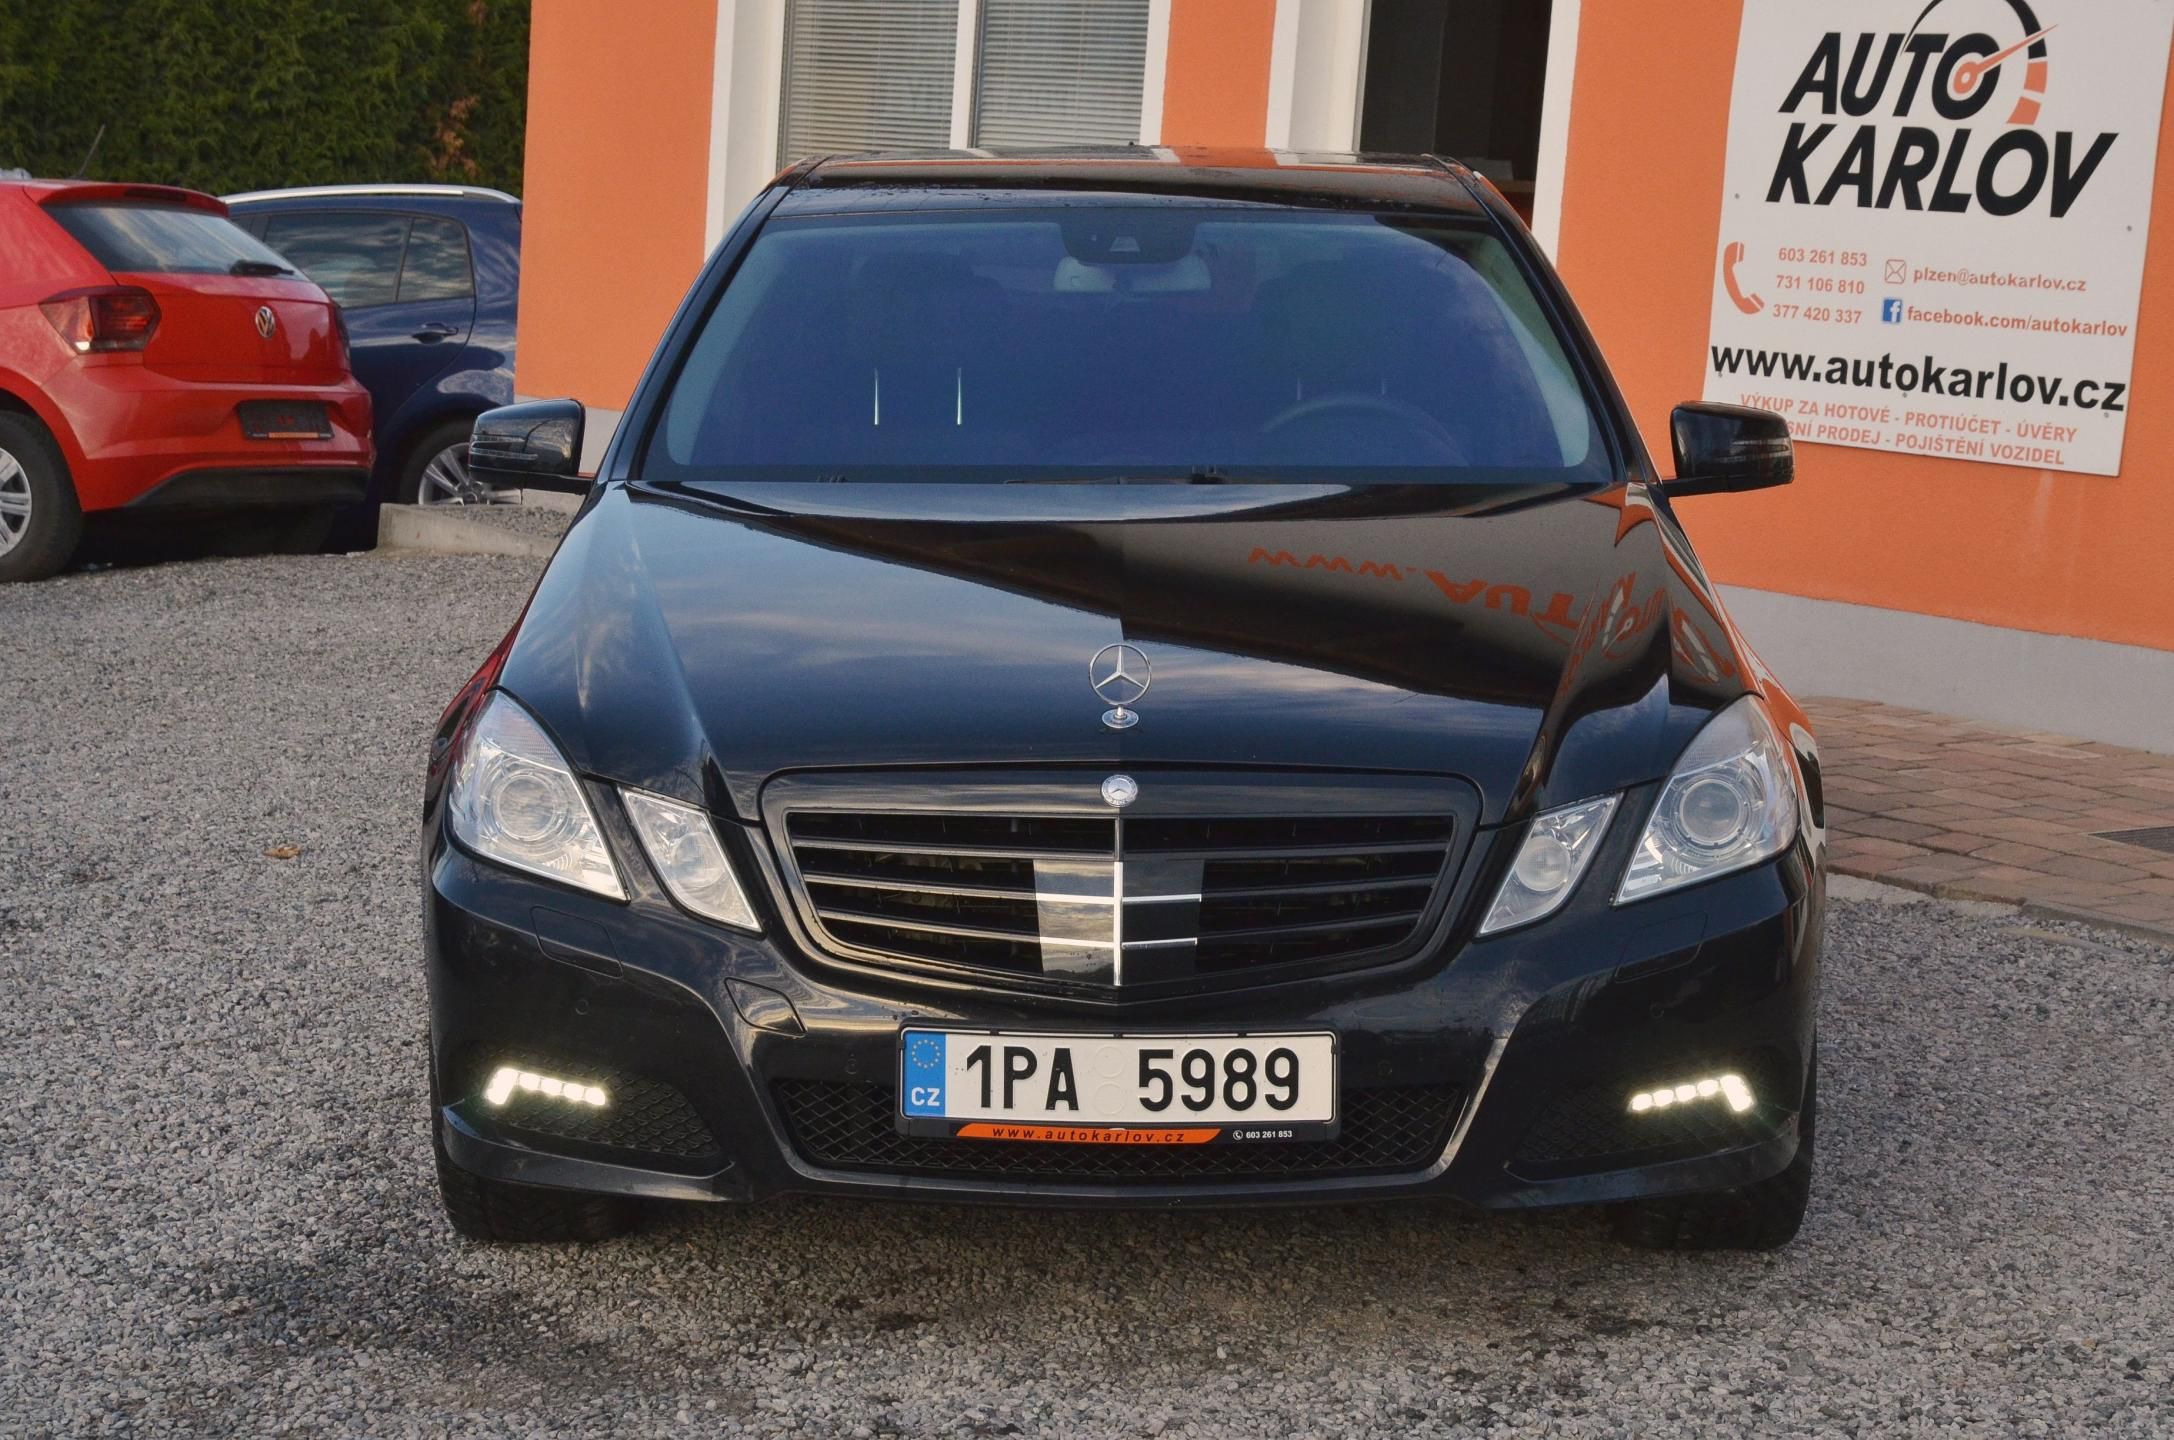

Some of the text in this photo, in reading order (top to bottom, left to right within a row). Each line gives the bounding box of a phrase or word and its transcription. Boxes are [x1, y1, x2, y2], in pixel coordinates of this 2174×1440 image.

[1777, 32, 2001, 120] AUTO
[1765, 123, 2119, 218] KARLOV
[1778, 248, 1867, 267] 603 261 853
[1776, 275, 1865, 294] 731 106 810
[1913, 267, 2087, 292] plzen@autokarlov.cz
[1773, 304, 1862, 324] 377 420 337
[1907, 306, 2128, 337] facebook.com/autokarlov
[1711, 345, 2126, 412] www.autokarlov.cz
[1798, 400, 1819, 416] ZA
[1824, 403, 1890, 423] HOTOVÉ
[1905, 412, 2002, 434] PROTIÚČET
[2016, 419, 2077, 443] ÚVĚRY
[1817, 424, 1881, 445] PRODEJ
[1895, 433, 1984, 456] POJIŠTĚNÍ
[1990, 443, 2065, 465] VOZIDEL
[966, 1045, 1299, 1112] 1PA 5989
[911, 1087, 940, 1106] CZ
[992, 1128, 1185, 1142] www.autokarlov.cz
[1246, 1130, 1293, 1139] 603 261 853
